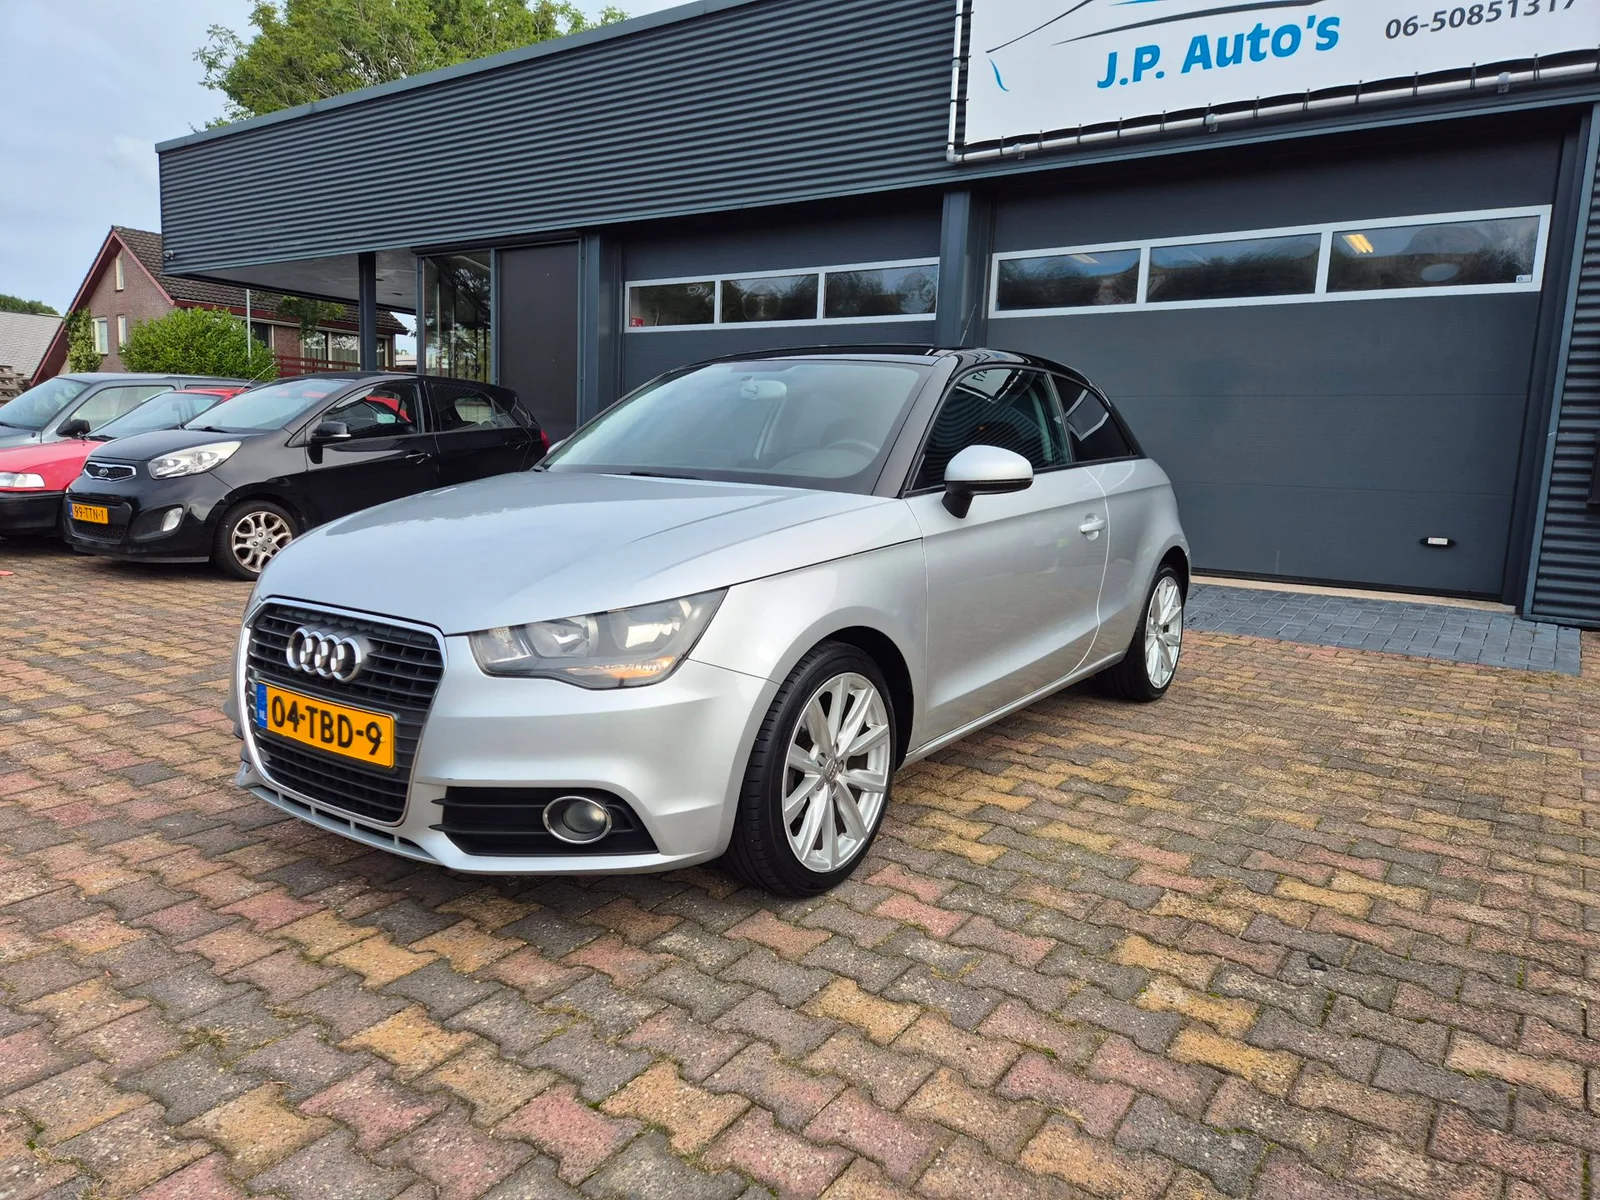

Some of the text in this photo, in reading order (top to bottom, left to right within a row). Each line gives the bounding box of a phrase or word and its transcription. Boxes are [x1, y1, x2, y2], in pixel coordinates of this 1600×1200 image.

[1096, 15, 1341, 89] J.P. Auto's
[74, 505, 104, 522] 99-TTN-1
[271, 695, 383, 756] 04-TBD-9
